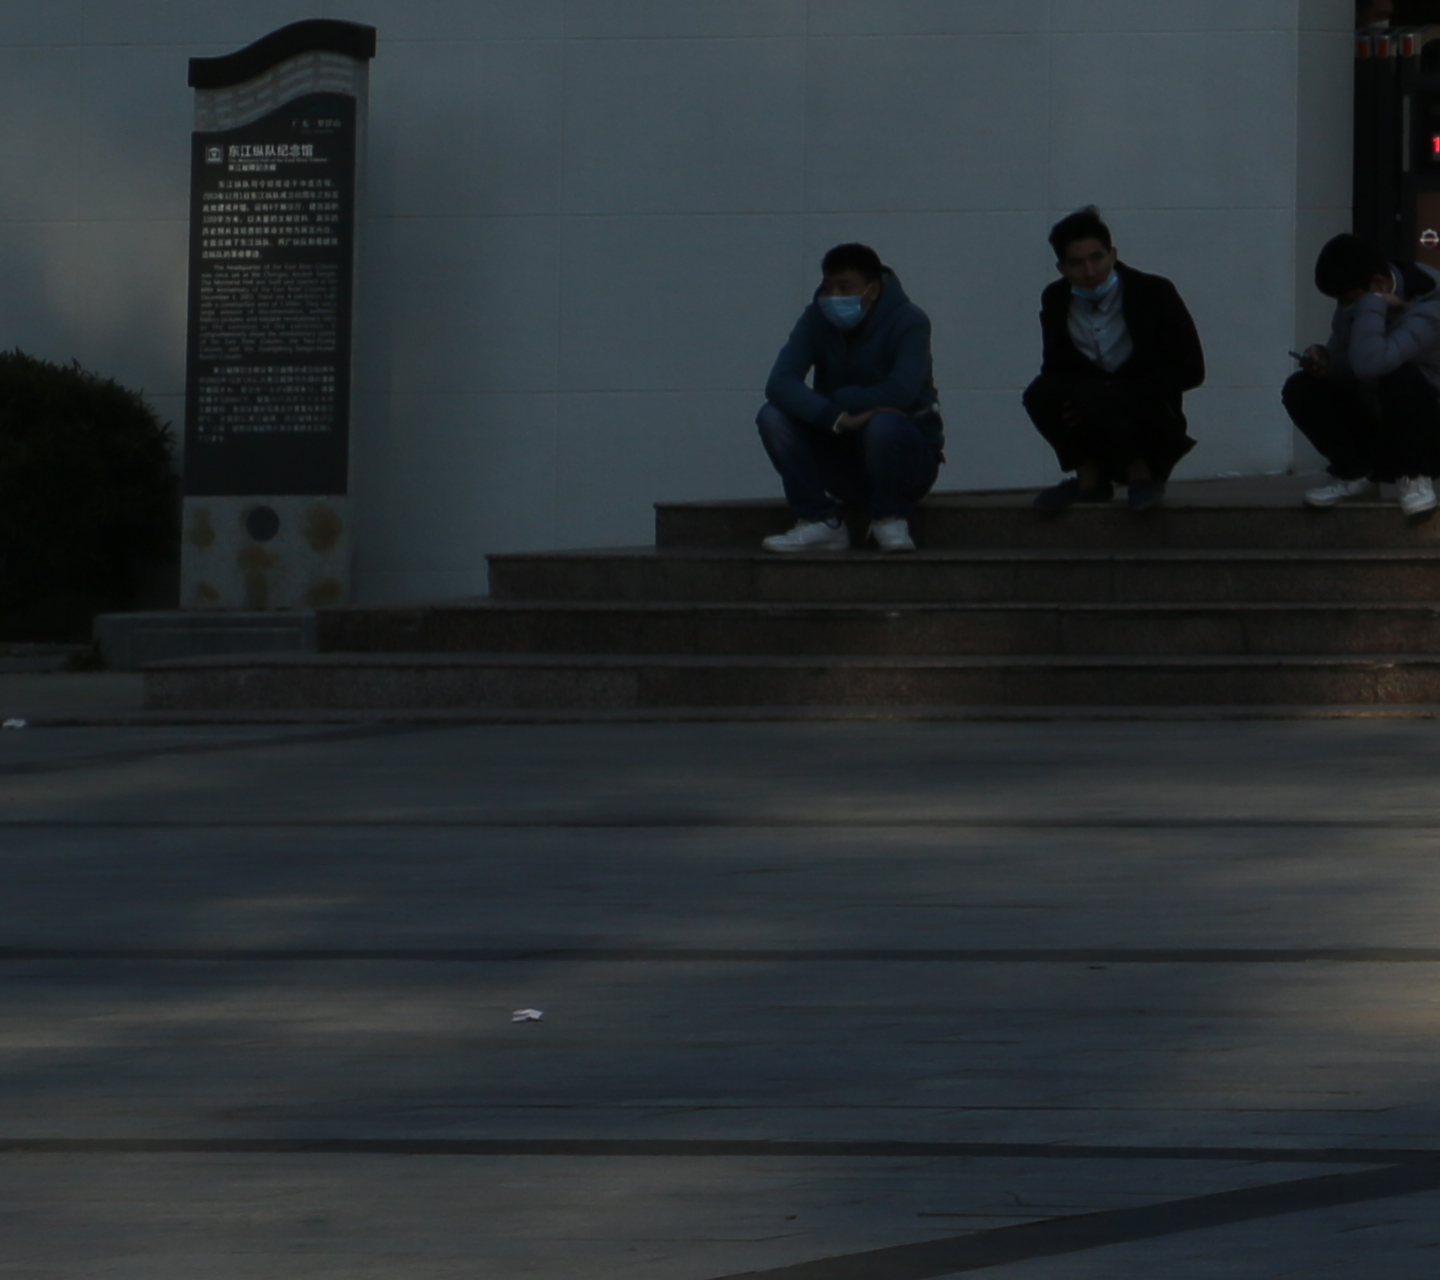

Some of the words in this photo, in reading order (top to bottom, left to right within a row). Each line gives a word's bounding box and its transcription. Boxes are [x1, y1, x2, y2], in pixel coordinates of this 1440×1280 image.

[228, 144, 314, 158] 东江纵队纪念馆
